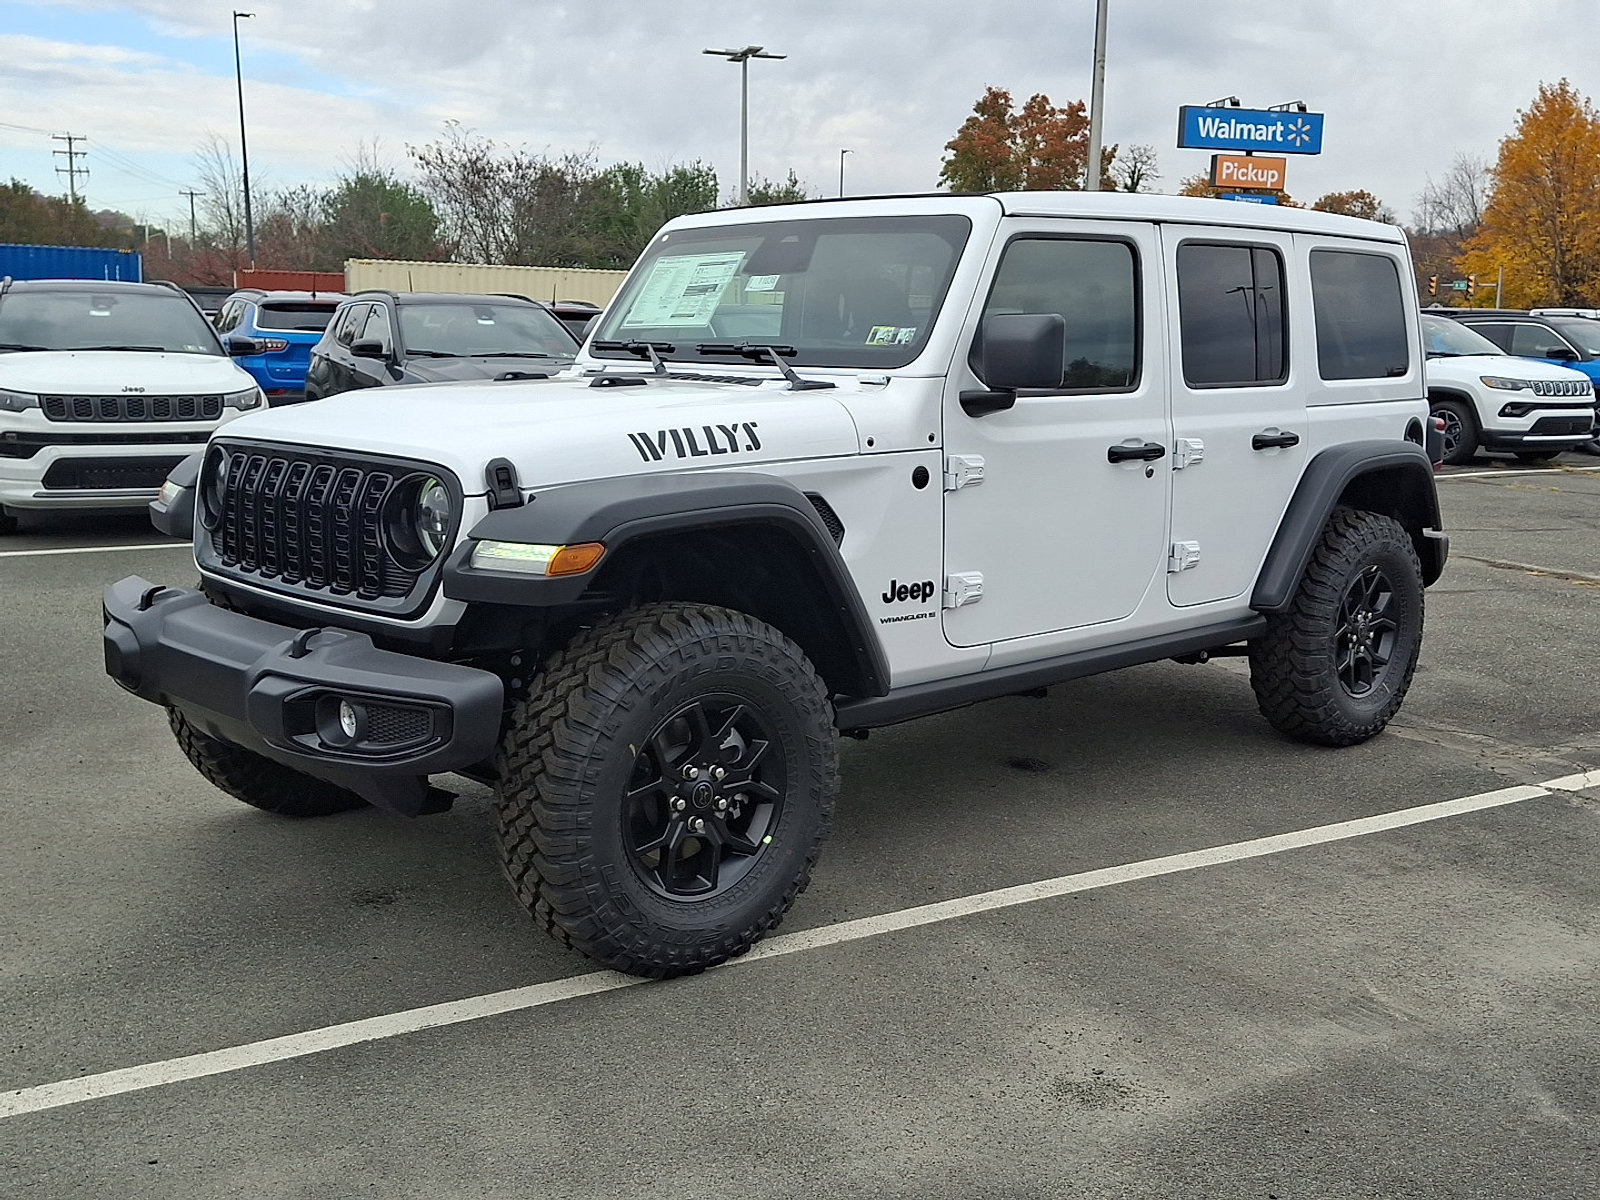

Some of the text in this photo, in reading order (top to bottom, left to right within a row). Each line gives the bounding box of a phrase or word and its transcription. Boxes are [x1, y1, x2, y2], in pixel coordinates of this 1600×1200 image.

[1198, 117, 1285, 142] Walmart
[1222, 161, 1278, 187] Pickup
[121, 385, 146, 393] Jeep
[627, 422, 761, 462] WILLYS
[882, 579, 935, 604] Jeep
[880, 613, 927, 624] WRANGLER
